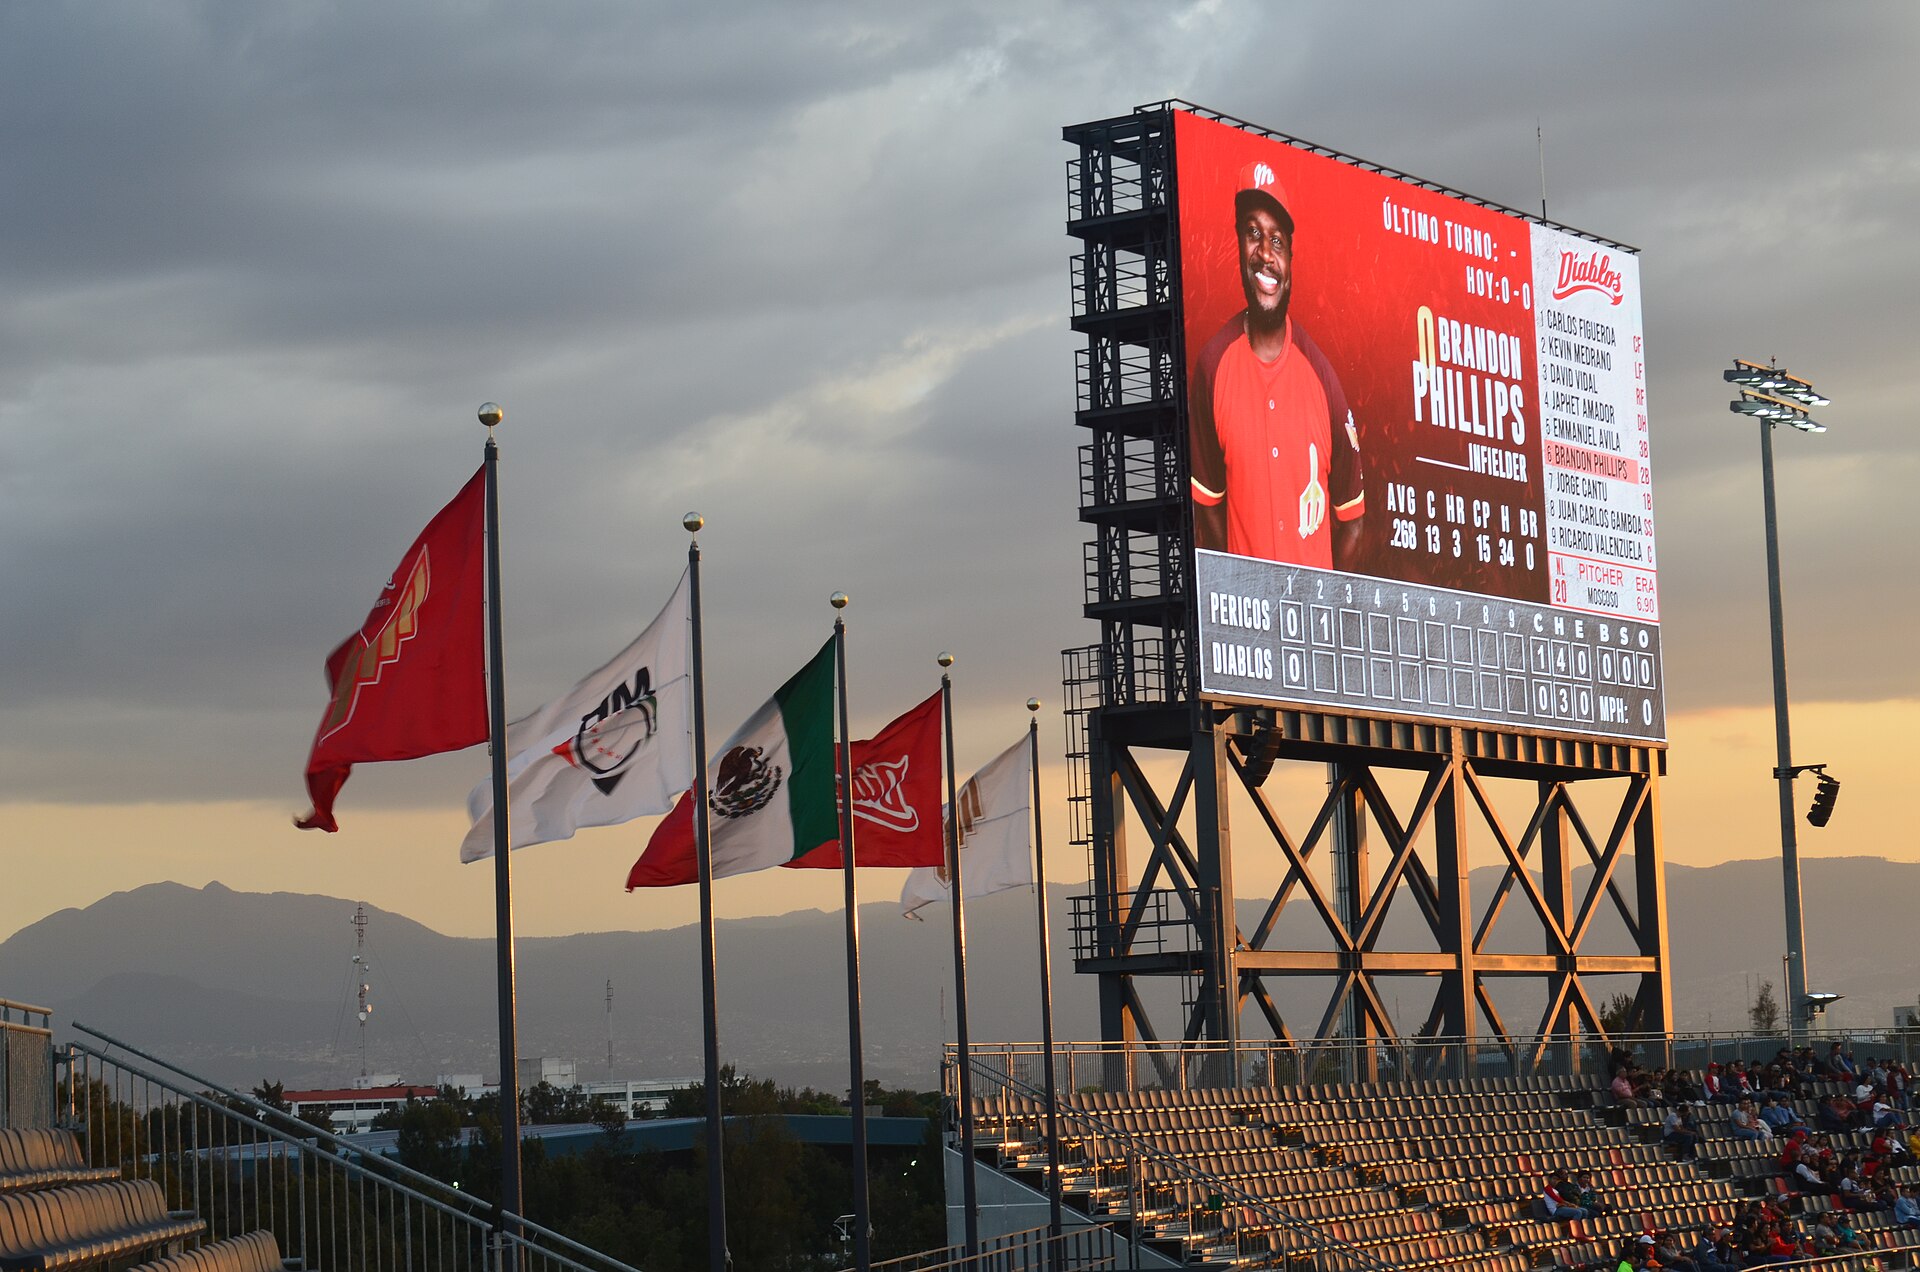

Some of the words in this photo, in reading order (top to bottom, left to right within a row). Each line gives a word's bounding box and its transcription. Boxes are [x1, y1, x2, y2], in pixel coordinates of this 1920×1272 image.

[1383, 196, 1439, 244] ÚLTIMO
[1445, 220, 1498, 262] TURNO:
[1557, 247, 1621, 293] Diablos
[1438, 316, 1522, 381] BRANDON
[1540, 311, 1544, 327] 1
[1547, 309, 1577, 336] CARLOS
[1579, 318, 1617, 347] FIGUEROA
[1541, 337, 1546, 354] 2
[1548, 335, 1572, 361] KEVIN
[1574, 343, 1612, 372] MEDRANO
[1634, 361, 1642, 380] LF
[1412, 360, 1526, 445] PHILLIPS
[1542, 364, 1548, 381] 3
[1550, 363, 1574, 388] DAVID
[1575, 369, 1599, 394] VIDAL
[1636, 387, 1645, 406] RF
[1544, 391, 1549, 408] 4
[1552, 390, 1580, 416] JAPHET
[1582, 398, 1616, 425] AMADOR
[1637, 414, 1647, 432] DH
[1545, 418, 1551, 435] 5
[1553, 418, 1597, 447] EMMANUEL
[1599, 428, 1621, 453] AVILA
[1639, 440, 1649, 458] 3B
[1468, 442, 1528, 483] INFIELDER
[1547, 445, 1552, 463] 6
[1555, 444, 1593, 473] BRANDON
[1593, 453, 1628, 480] PHILLIPS
[1640, 466, 1650, 485] 2B
[1387, 482, 1416, 515] AVG
[1426, 490, 1436, 519] C
[1445, 493, 1466, 525] HR
[1472, 499, 1491, 529] CP
[1500, 505, 1510, 533] H
[1519, 508, 1538, 539] BR
[1548, 472, 1553, 490] 7
[1556, 471, 1580, 496] JORGE
[1582, 477, 1608, 502] CANTU
[1642, 493, 1652, 511] 1B
[1550, 499, 1555, 517] 8
[1558, 499, 1578, 522] JUAN
[1579, 503, 1609, 529] CARLOS
[1610, 510, 1643, 536] GAMBOA
[1643, 518, 1653, 537] SS
[1390, 518, 1417, 550] .268
[1425, 524, 1441, 554] 13
[1452, 528, 1462, 558] 3
[1476, 534, 1491, 563] 15
[1498, 538, 1515, 567] 34
[1525, 542, 1535, 571] 0
[1551, 527, 1557, 544] 9
[1559, 526, 1593, 552] RICARDO
[1594, 533, 1643, 562] VALENZUELA
[1647, 545, 1653, 563] C
[1555, 579, 1567, 603] 20
[1587, 587, 1619, 608] MOSCOSO
[1636, 596, 1655, 613] 6.90
[1578, 563, 1624, 587] PITCHER
[1635, 577, 1655, 594] ERA
[1286, 575, 1292, 595] 1
[1317, 579, 1324, 600] 2
[1345, 583, 1352, 604] 3
[1374, 588, 1381, 608] 4
[1402, 593, 1409, 612] 5
[1429, 596, 1436, 616] 6
[1455, 601, 1462, 620] 7
[1482, 605, 1489, 624] 8
[1508, 609, 1515, 628] 9
[1533, 613, 1543, 633] C
[1554, 616, 1564, 636] H
[1575, 619, 1584, 639] E
[1599, 623, 1610, 642] B
[1619, 626, 1629, 646] S
[1638, 629, 1649, 649] O
[1210, 591, 1271, 631] PERICOS
[1286, 607, 1298, 637] 0
[1319, 612, 1329, 641] 1
[1537, 644, 1545, 669] 1
[1556, 647, 1566, 672] 4
[1577, 650, 1587, 675] 0
[1602, 653, 1612, 679] 0
[1622, 655, 1632, 682] 0
[1640, 658, 1650, 684] 0
[1212, 641, 1273, 680] DIABLOS
[1289, 653, 1300, 683] 0
[1599, 695, 1629, 724] MPH:
[1642, 698, 1653, 726] 0
